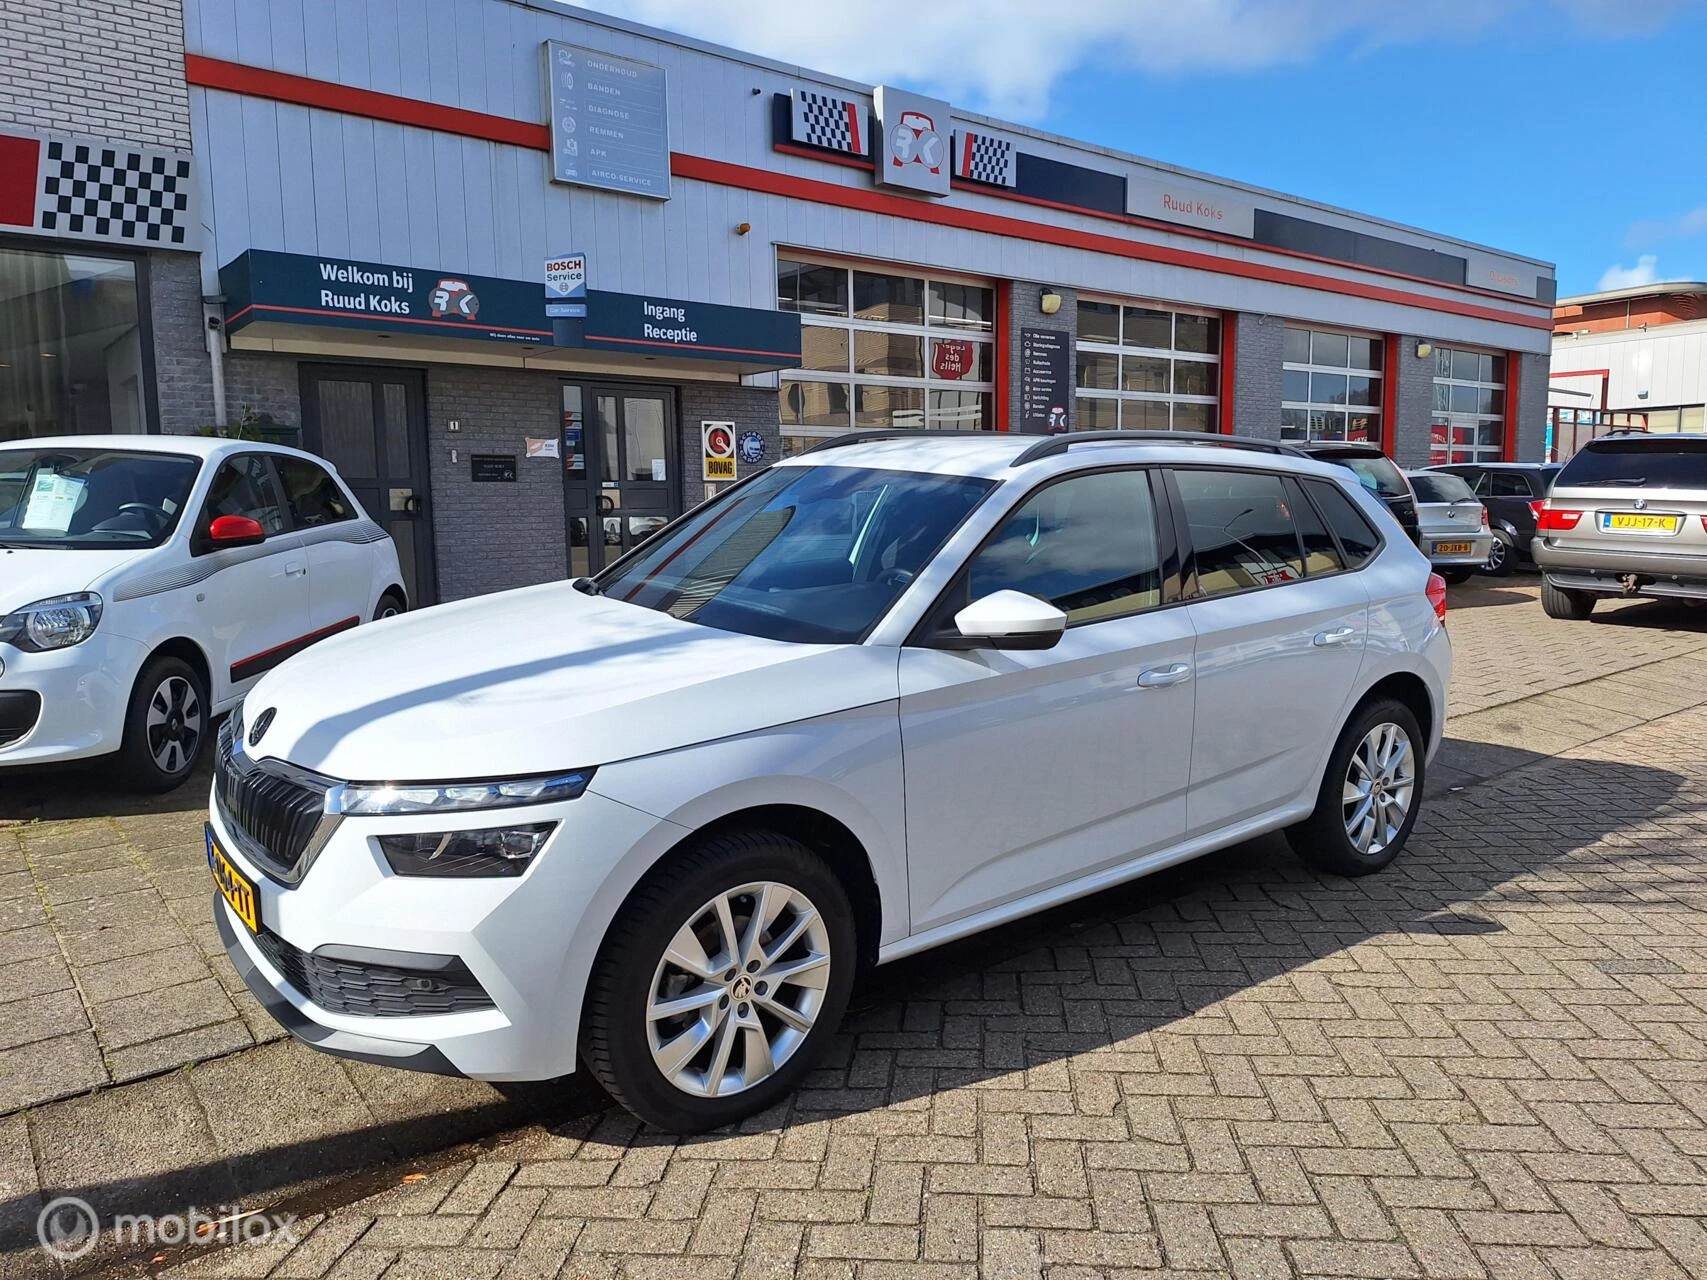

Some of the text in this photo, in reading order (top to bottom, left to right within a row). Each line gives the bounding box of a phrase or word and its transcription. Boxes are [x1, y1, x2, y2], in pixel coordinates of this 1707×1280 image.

[587, 60, 638, 78] ONDERHOUD
[587, 82, 621, 96] BANDEN
[588, 104, 630, 120] DIAGNOSE
[589, 126, 624, 139] REMMEN
[590, 148, 607, 158] APK
[1163, 193, 1223, 220] Ruud Koks
[546, 260, 582, 272] BOSCH
[320, 263, 413, 293] Welkom bij
[546, 272, 582, 281] Service
[320, 289, 410, 314] Ruud Koks
[643, 301, 685, 322] Ingang
[643, 323, 698, 343] Receptie
[708, 461, 733, 475] BOVAG
[1617, 516, 1666, 529] VJJ-17-K
